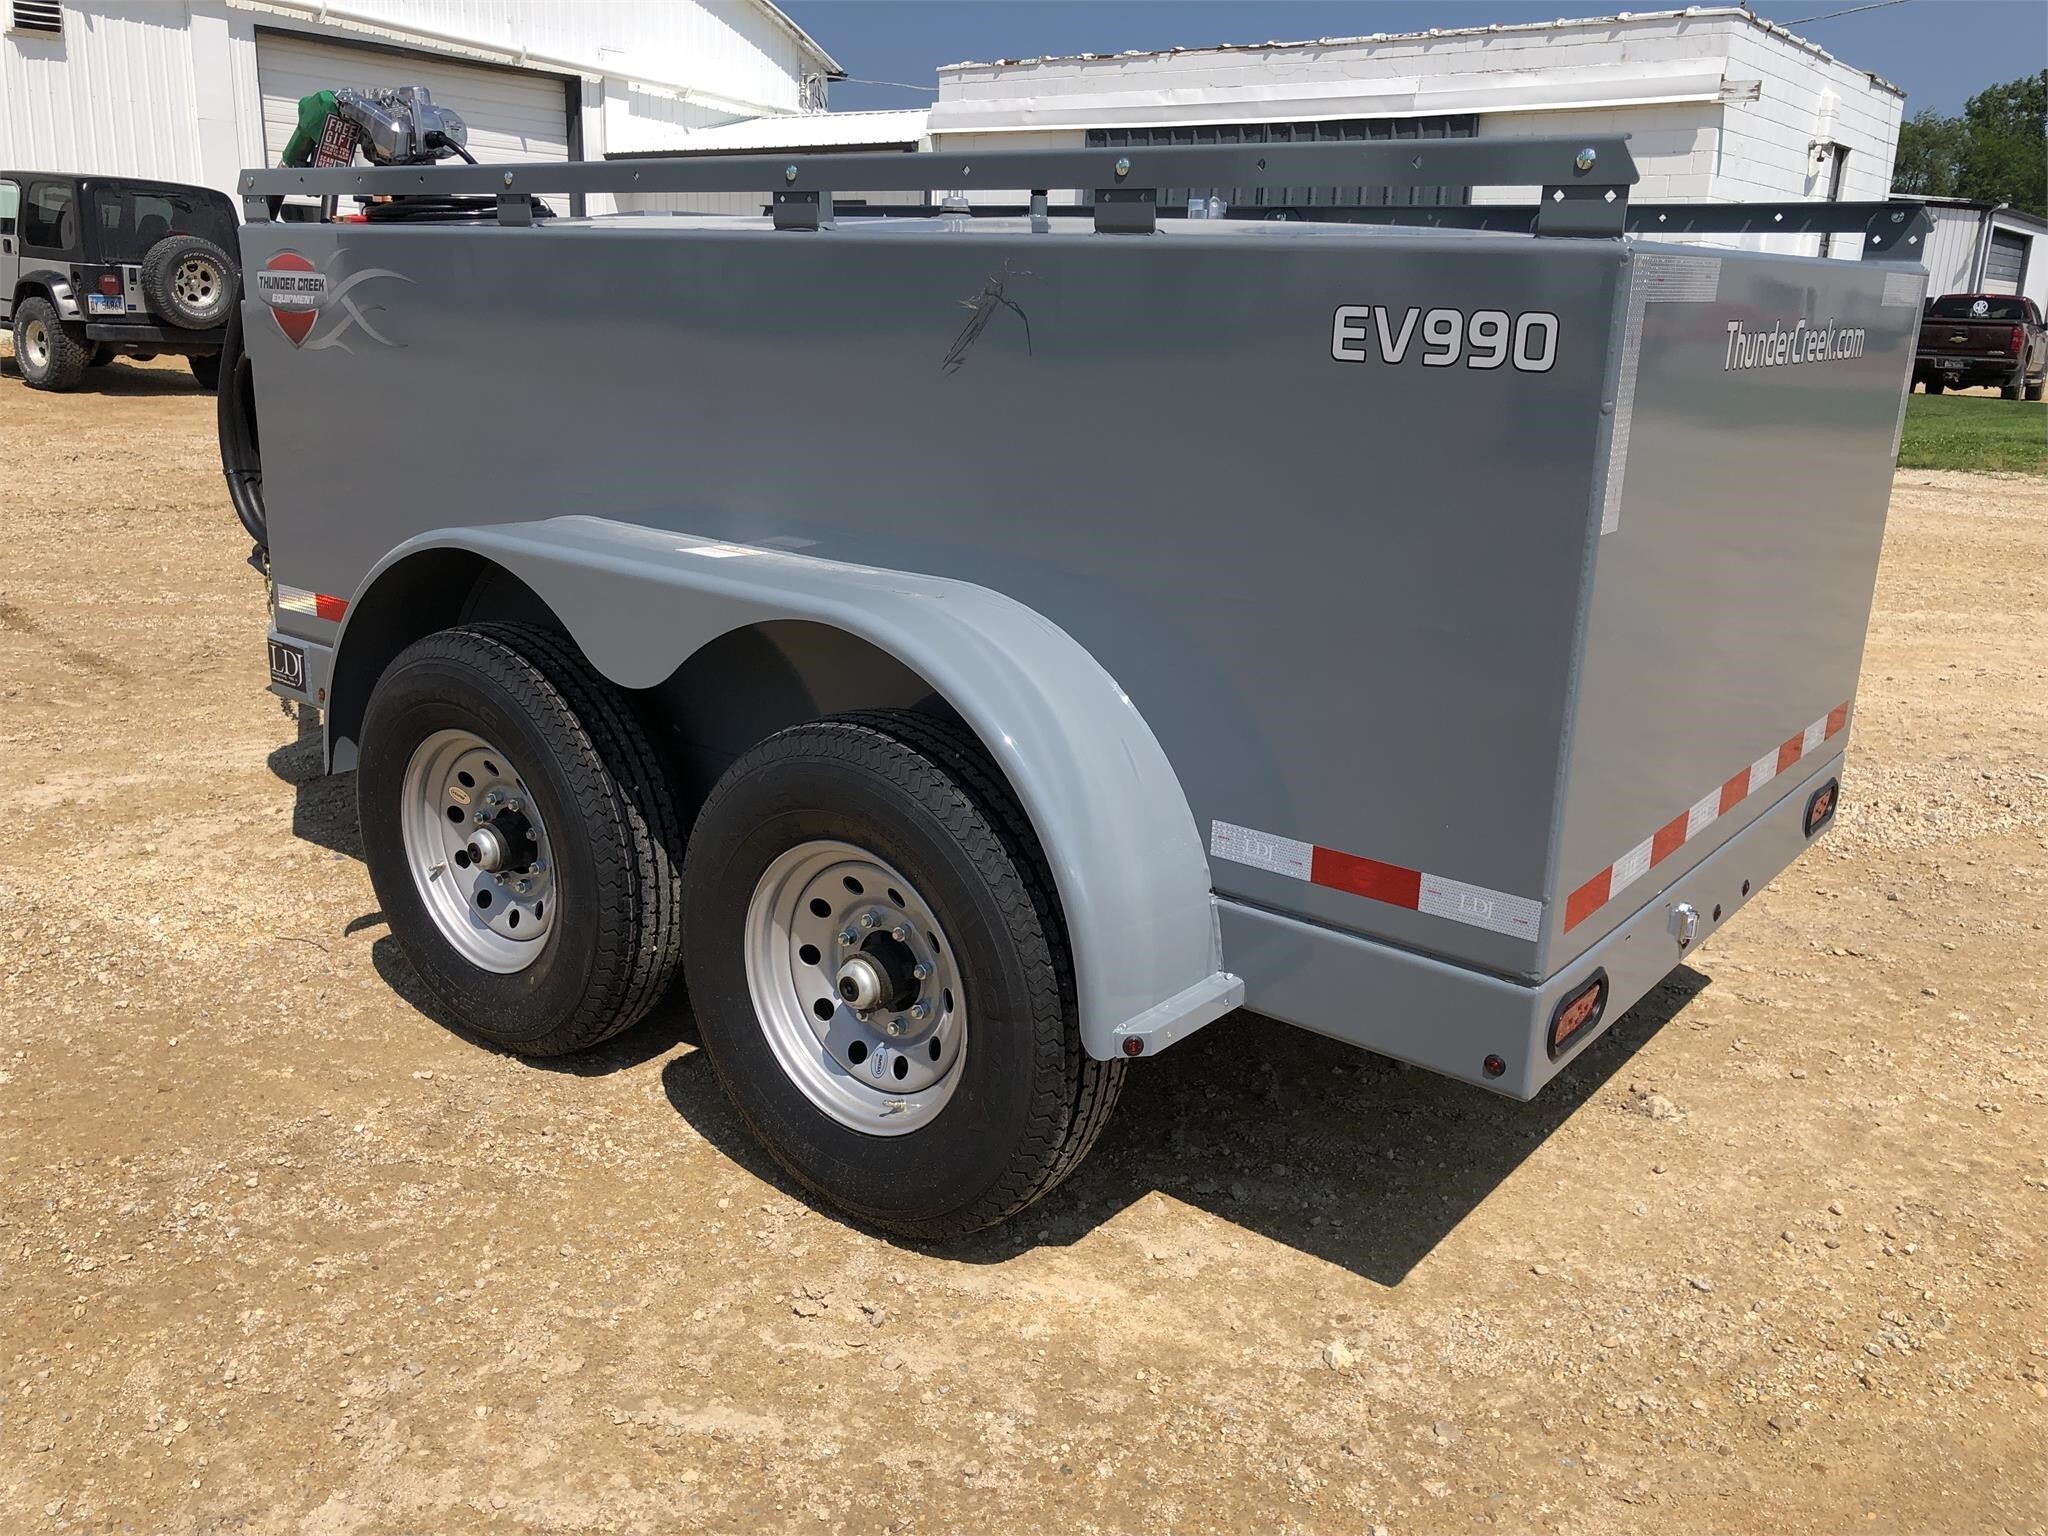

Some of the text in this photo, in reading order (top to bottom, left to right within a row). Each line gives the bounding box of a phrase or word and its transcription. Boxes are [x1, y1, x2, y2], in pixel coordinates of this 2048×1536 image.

[328, 118, 357, 138] FREE
[325, 130, 352, 149] GIFT
[259, 276, 325, 292] THUNDER CREEK
[271, 293, 315, 304] EQUIPMENT
[1331, 304, 1560, 373] EV990
[1724, 317, 1865, 371] ThunderCreek.com
[270, 645, 303, 688] LDJ
